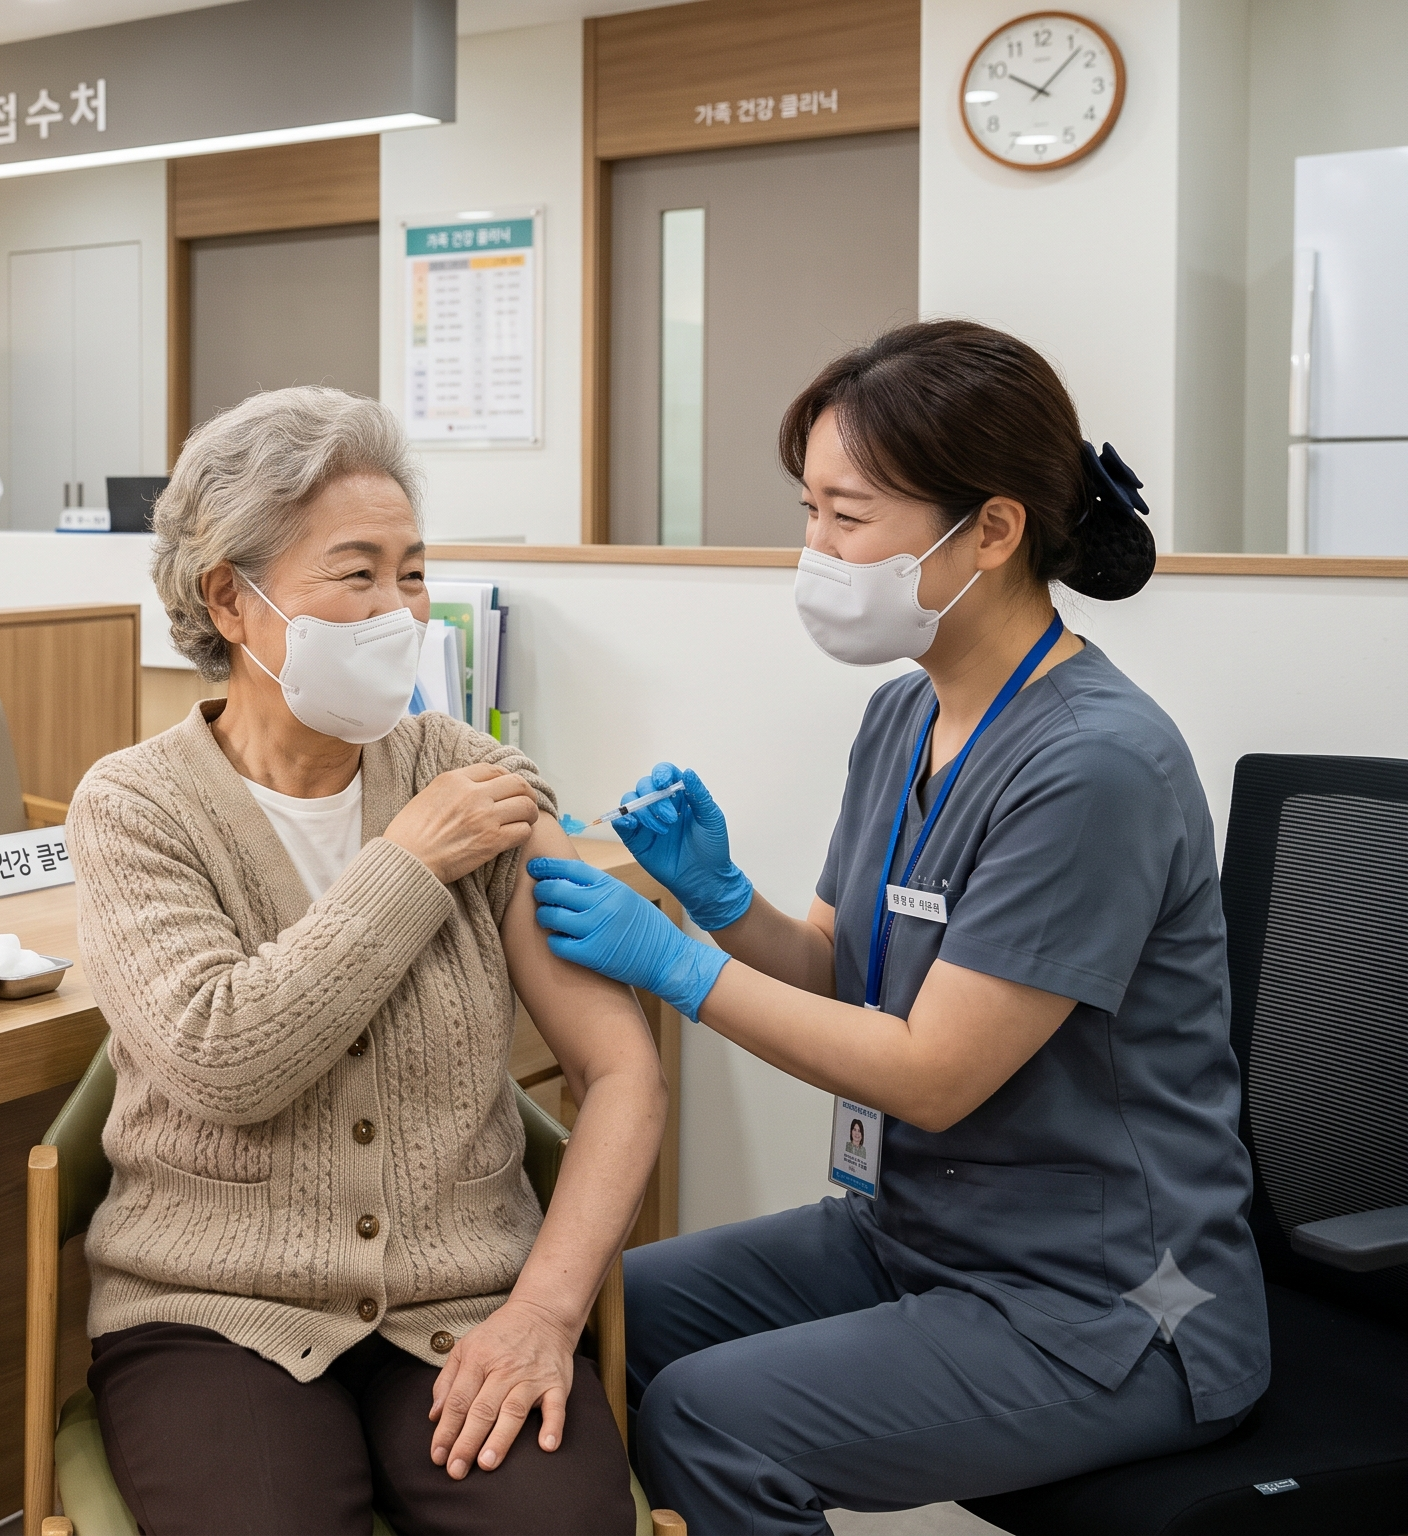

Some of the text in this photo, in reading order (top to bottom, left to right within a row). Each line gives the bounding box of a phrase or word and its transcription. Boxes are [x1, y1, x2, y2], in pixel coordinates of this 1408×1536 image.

[1033, 28, 1053, 48] 12
[1067, 34, 1075, 50] 1
[1007, 40, 1023, 58] 11
[1083, 51, 1097, 69] 2
[987, 60, 1008, 79] 10
[1092, 77, 1105, 94] 3
[694, 102, 731, 127] 가족
[737, 96, 775, 123] 건강
[1083, 105, 1096, 121] 4
[986, 115, 1000, 133] 8
[1062, 126, 1075, 144] 5
